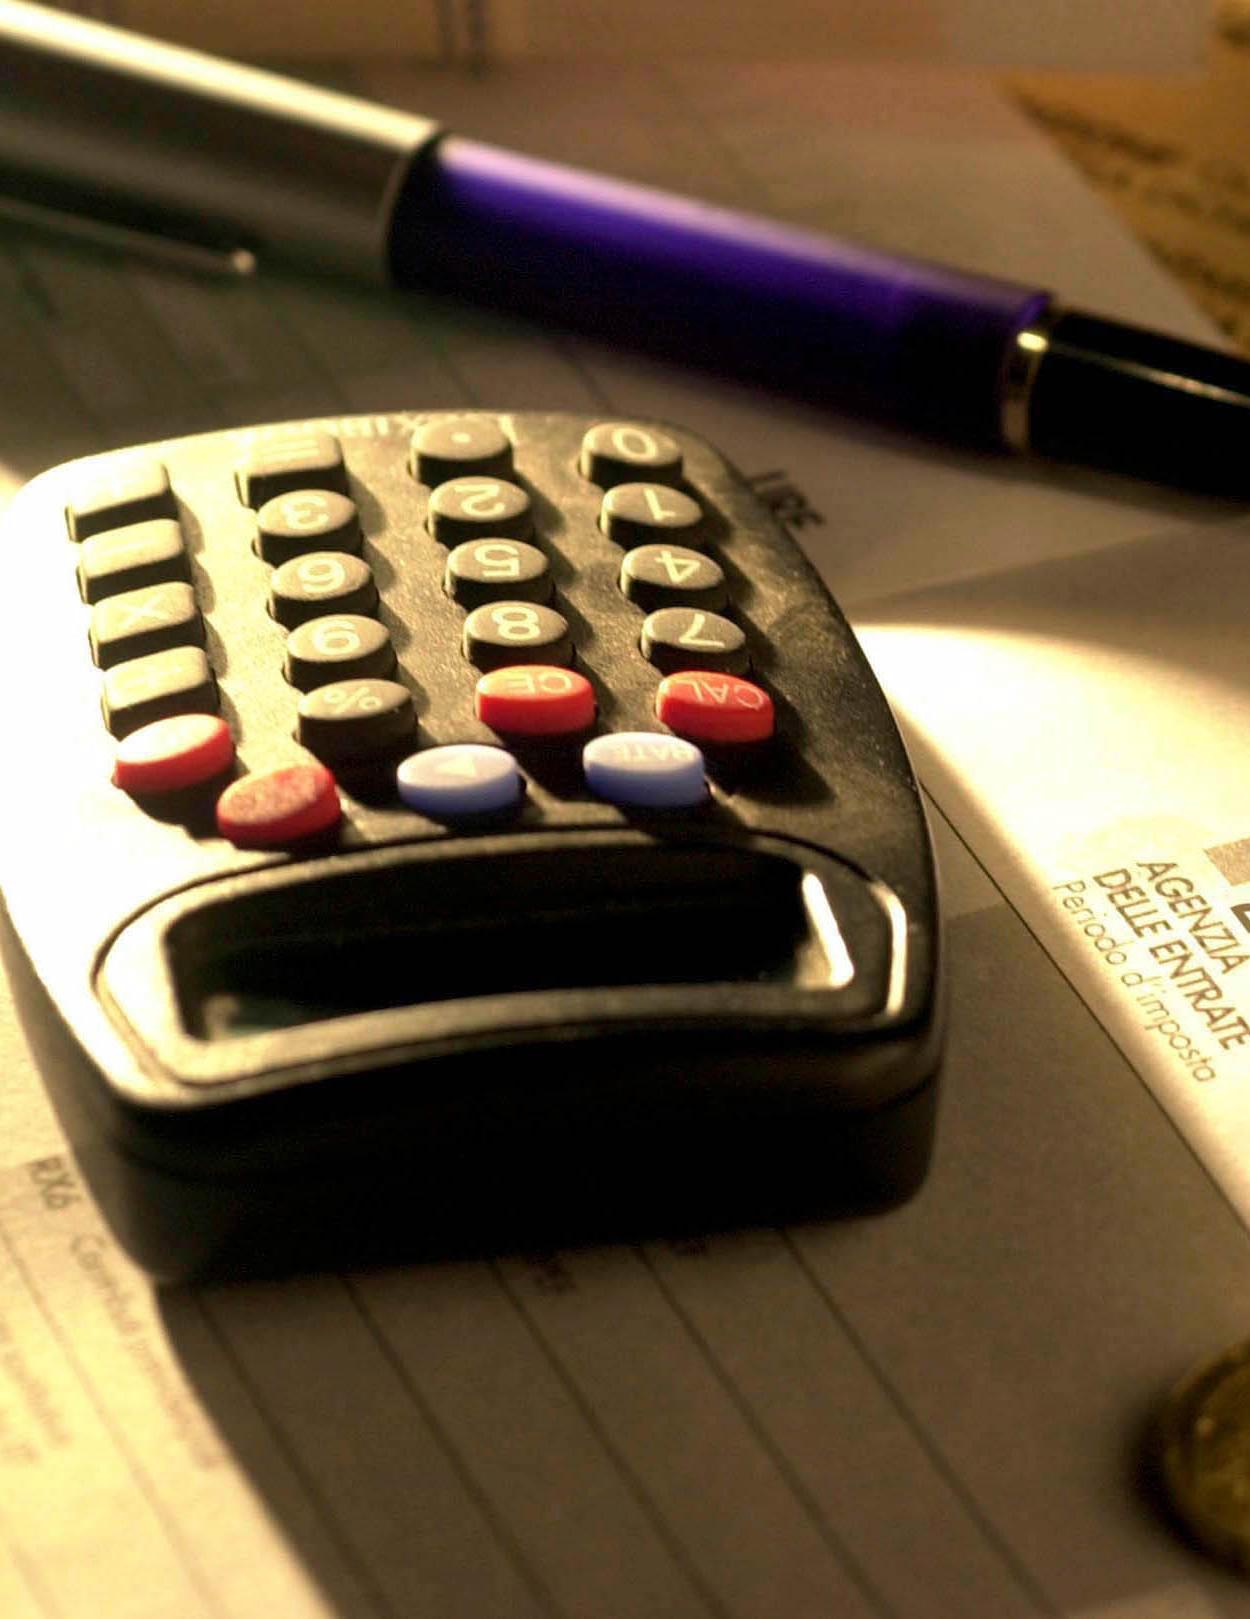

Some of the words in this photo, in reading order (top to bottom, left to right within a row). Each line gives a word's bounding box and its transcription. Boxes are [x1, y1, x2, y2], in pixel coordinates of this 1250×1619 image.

[281, 494, 332, 531] 3
[453, 482, 506, 518] 2
[642, 487, 677, 521] 1
[473, 543, 521, 578] 5
[655, 550, 701, 583] 4
[490, 605, 542, 641] 8
[678, 612, 726, 649] 7
[504, 672, 573, 694] CE
[1092, 867, 1174, 939] DELLE
[1052, 880, 1136, 966] Periodo
